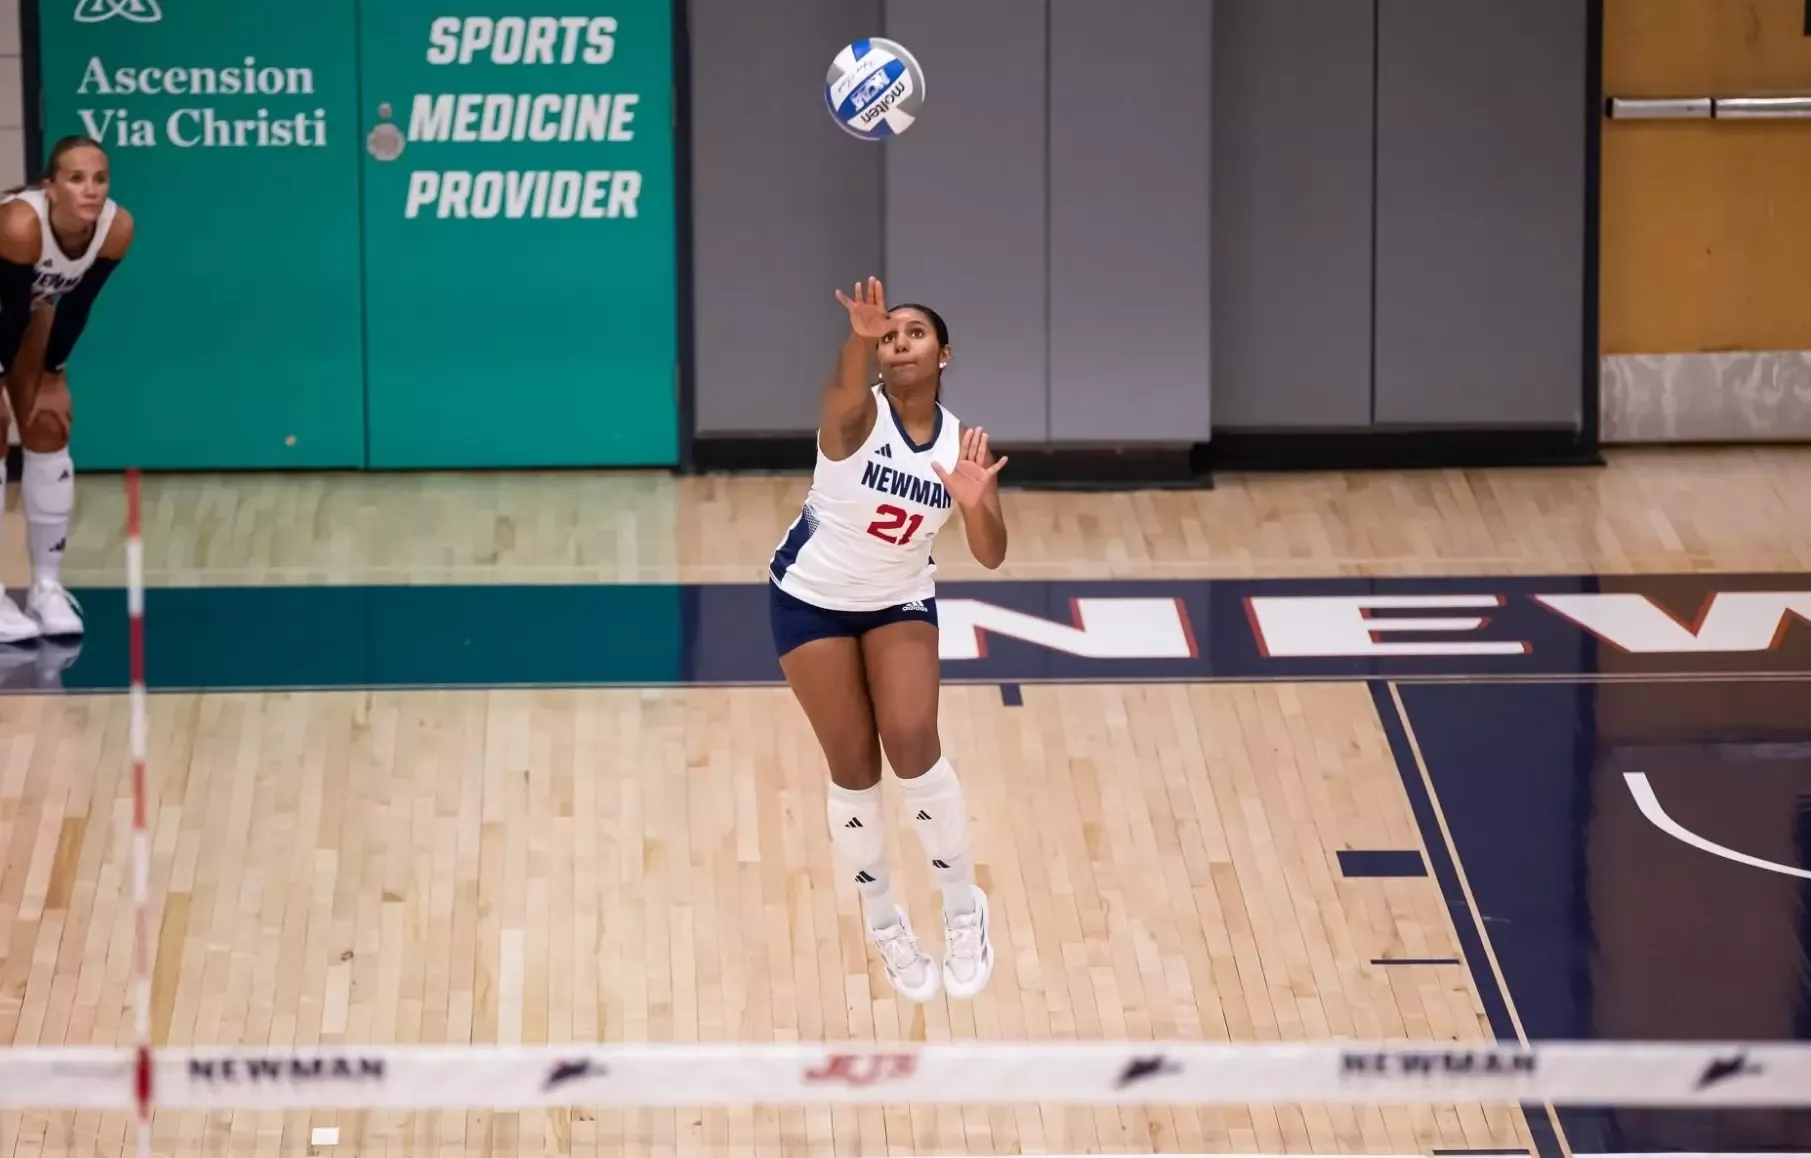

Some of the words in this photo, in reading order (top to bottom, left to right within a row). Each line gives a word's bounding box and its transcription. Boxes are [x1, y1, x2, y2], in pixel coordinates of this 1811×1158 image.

[426, 16, 618, 65] SPORTS
[76, 56, 315, 94] Ascension
[407, 93, 640, 142] MEDICINE
[860, 81, 905, 123] molten
[77, 109, 157, 147] Via
[166, 108, 327, 147] Christi
[404, 170, 644, 219] PROVIDER
[866, 504, 924, 546] 21
[187, 1057, 385, 1082] NEWMAN
[1340, 1053, 1537, 1077] NEWMAN
